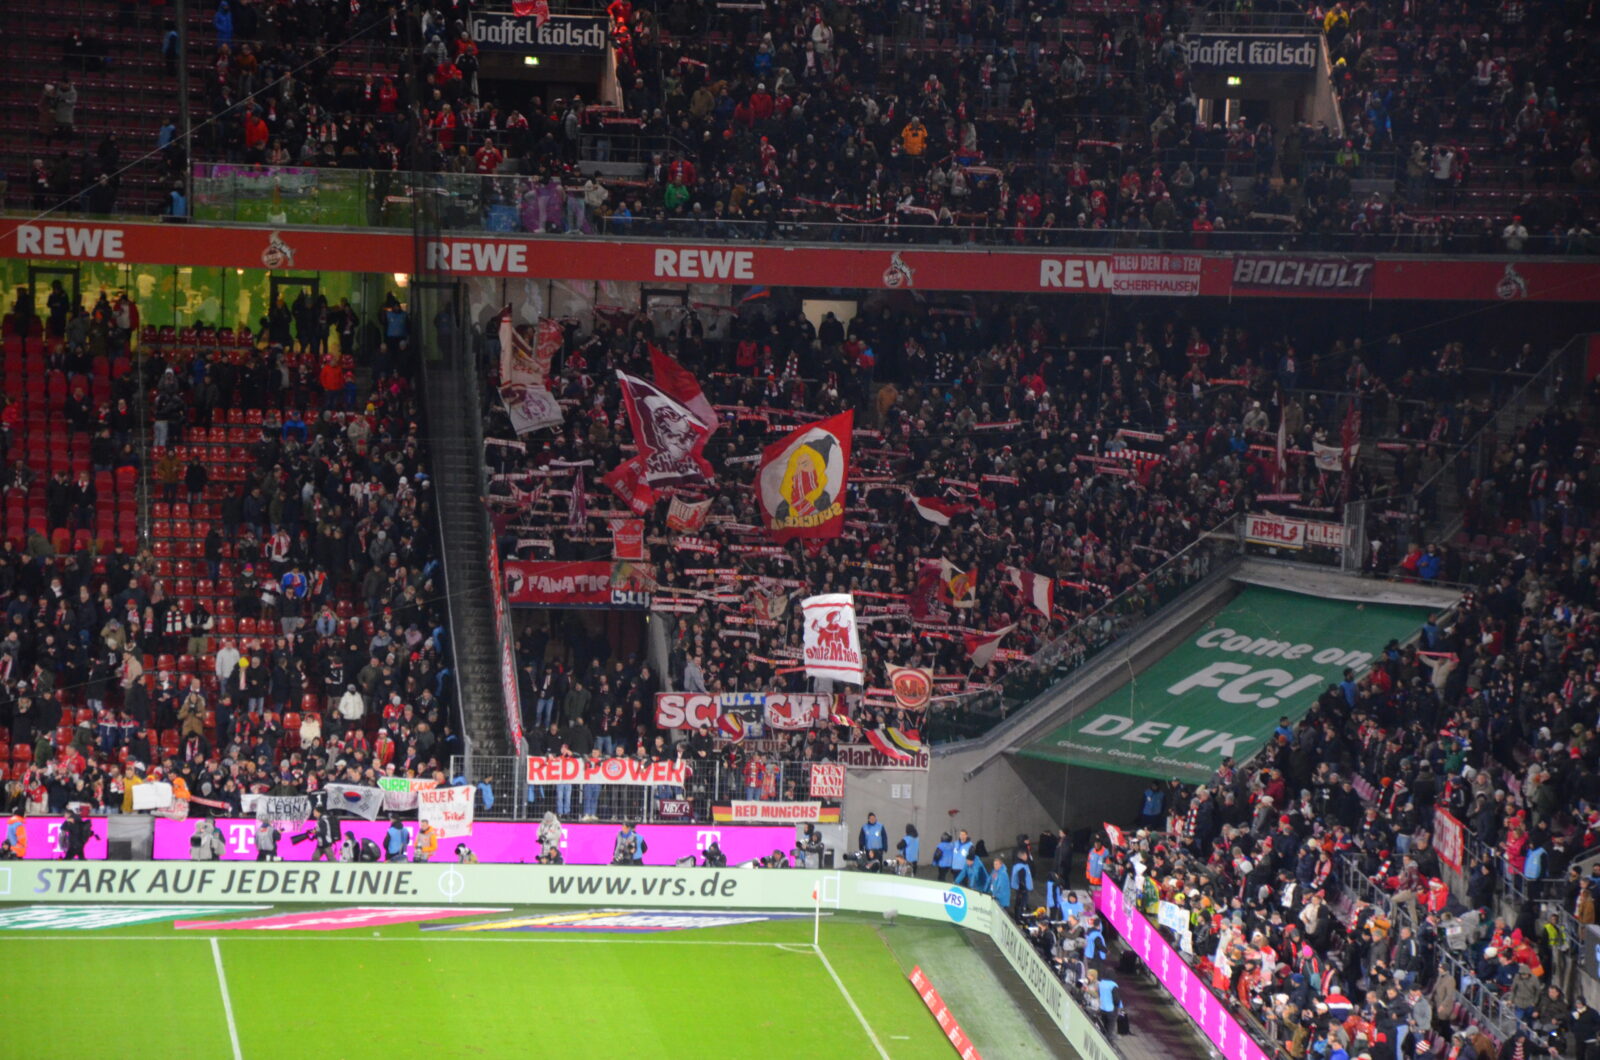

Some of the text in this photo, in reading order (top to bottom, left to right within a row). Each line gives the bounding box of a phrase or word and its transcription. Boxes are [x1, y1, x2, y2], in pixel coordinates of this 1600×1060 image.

[473, 17, 605, 50] Gaffel Kölsch
[1249, 41, 1316, 68] Kölsch
[17, 225, 124, 259] REWE
[426, 242, 528, 273] REWE
[654, 249, 754, 279] REWE
[1114, 256, 1137, 271] TREU
[1113, 279, 1199, 292] SCHERFHAUSEN
[1233, 258, 1373, 287] BOCHOLT
[1251, 520, 1298, 541] REBELS
[1196, 628, 1314, 660] Come
[1167, 661, 1324, 708] FC!
[1078, 713, 1256, 757] DEVK
[528, 757, 684, 783] RED POWER
[422, 789, 454, 803] NEUER
[735, 806, 757, 818] RED
[229, 824, 256, 853] T
[34, 868, 418, 895] STARK AUF JEDER LINIE.
[548, 872, 738, 897] www.vrs.de
[943, 892, 962, 906] VRS
